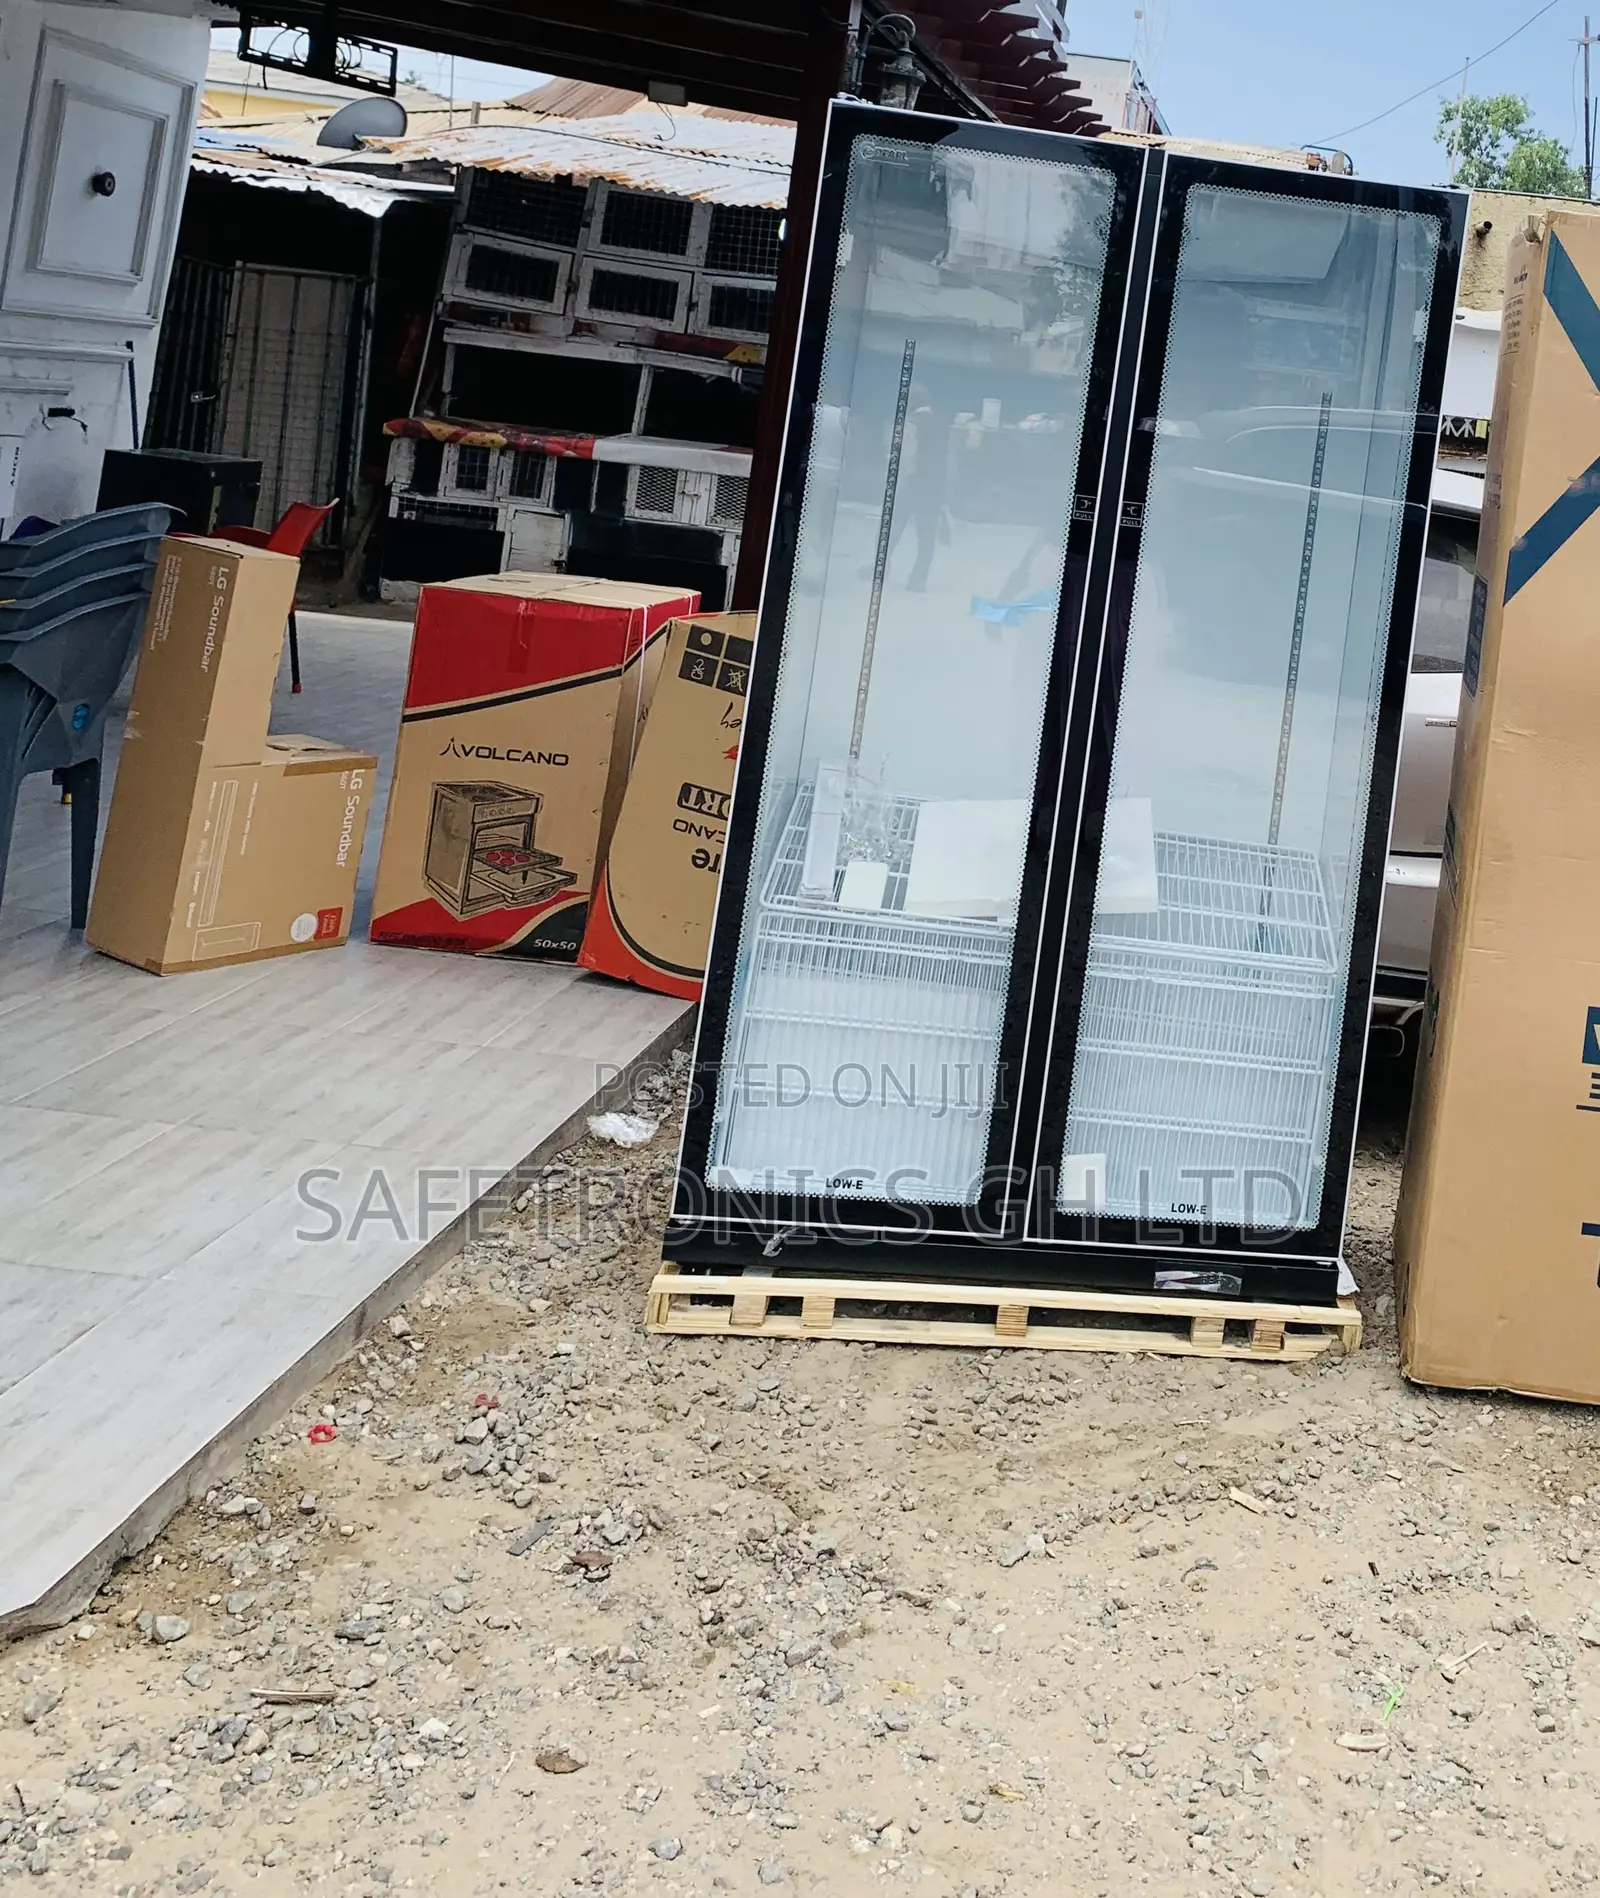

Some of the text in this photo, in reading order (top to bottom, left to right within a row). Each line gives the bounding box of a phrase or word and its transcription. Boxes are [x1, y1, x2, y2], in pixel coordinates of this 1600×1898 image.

[201, 566, 229, 673] LG Soundbar
[461, 744, 569, 767] VOLCANO
[336, 769, 365, 868] LG Soundbar
[533, 937, 577, 951] 50x50
[825, 1176, 863, 1191] LOW-E
[1170, 1201, 1208, 1216] LOW-E
